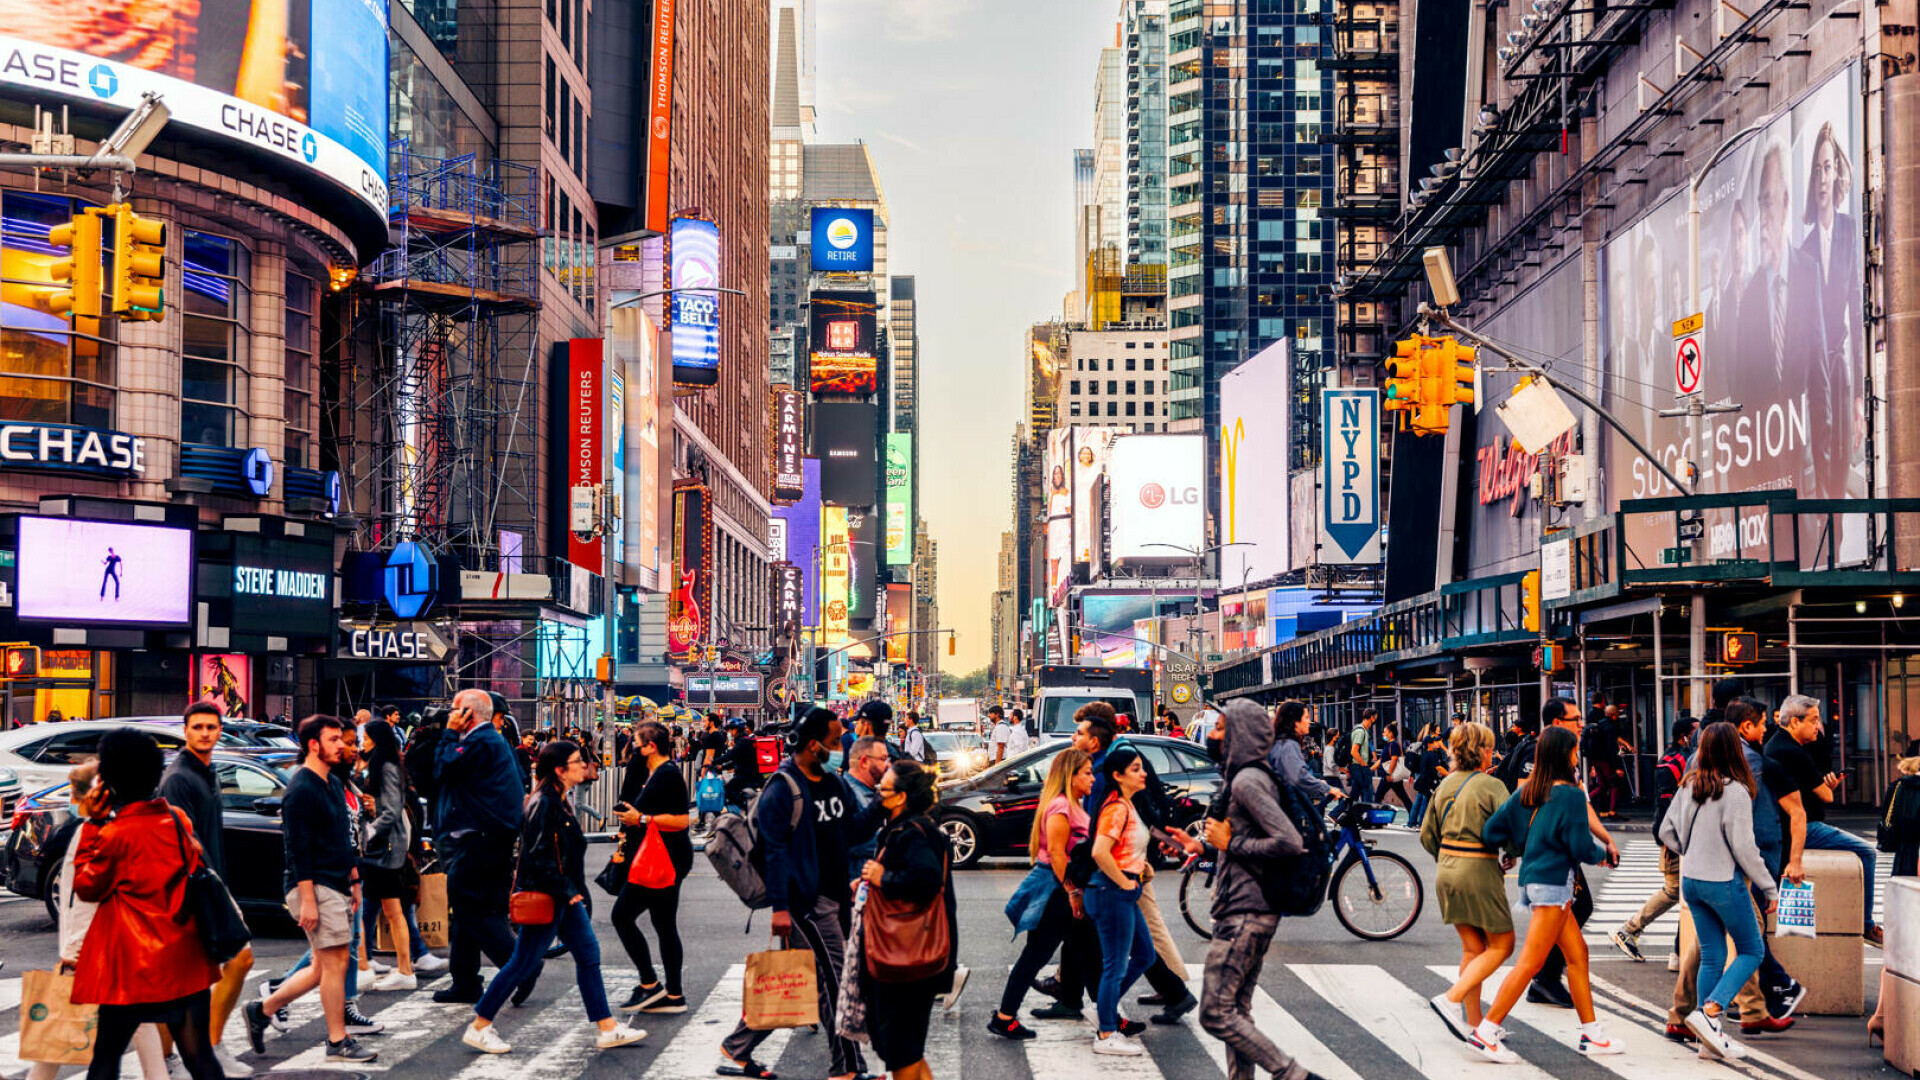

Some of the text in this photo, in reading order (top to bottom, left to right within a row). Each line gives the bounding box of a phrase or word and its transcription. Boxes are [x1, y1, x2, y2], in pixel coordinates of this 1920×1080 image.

[657, 47, 668, 108] THOMSON
[221, 104, 299, 154] CHASE
[1715, 178, 1736, 202] MOVE
[827, 250, 857, 261] RETIRE
[677, 298, 714, 313] TACO
[681, 311, 715, 326] BELL
[581, 370, 592, 487] OMSON REUTERS
[783, 394, 797, 473] CARMINES
[0, 424, 145, 473] CHASE
[1340, 398, 1361, 521] NYPD
[1632, 393, 1807, 499] SUCESSION
[1171, 487, 1198, 505] LG
[235, 566, 325, 600] STEVE MADDEN
[352, 630, 428, 659] CHASE
[814, 796, 844, 822] XO
[432, 921, 441, 932] 21
